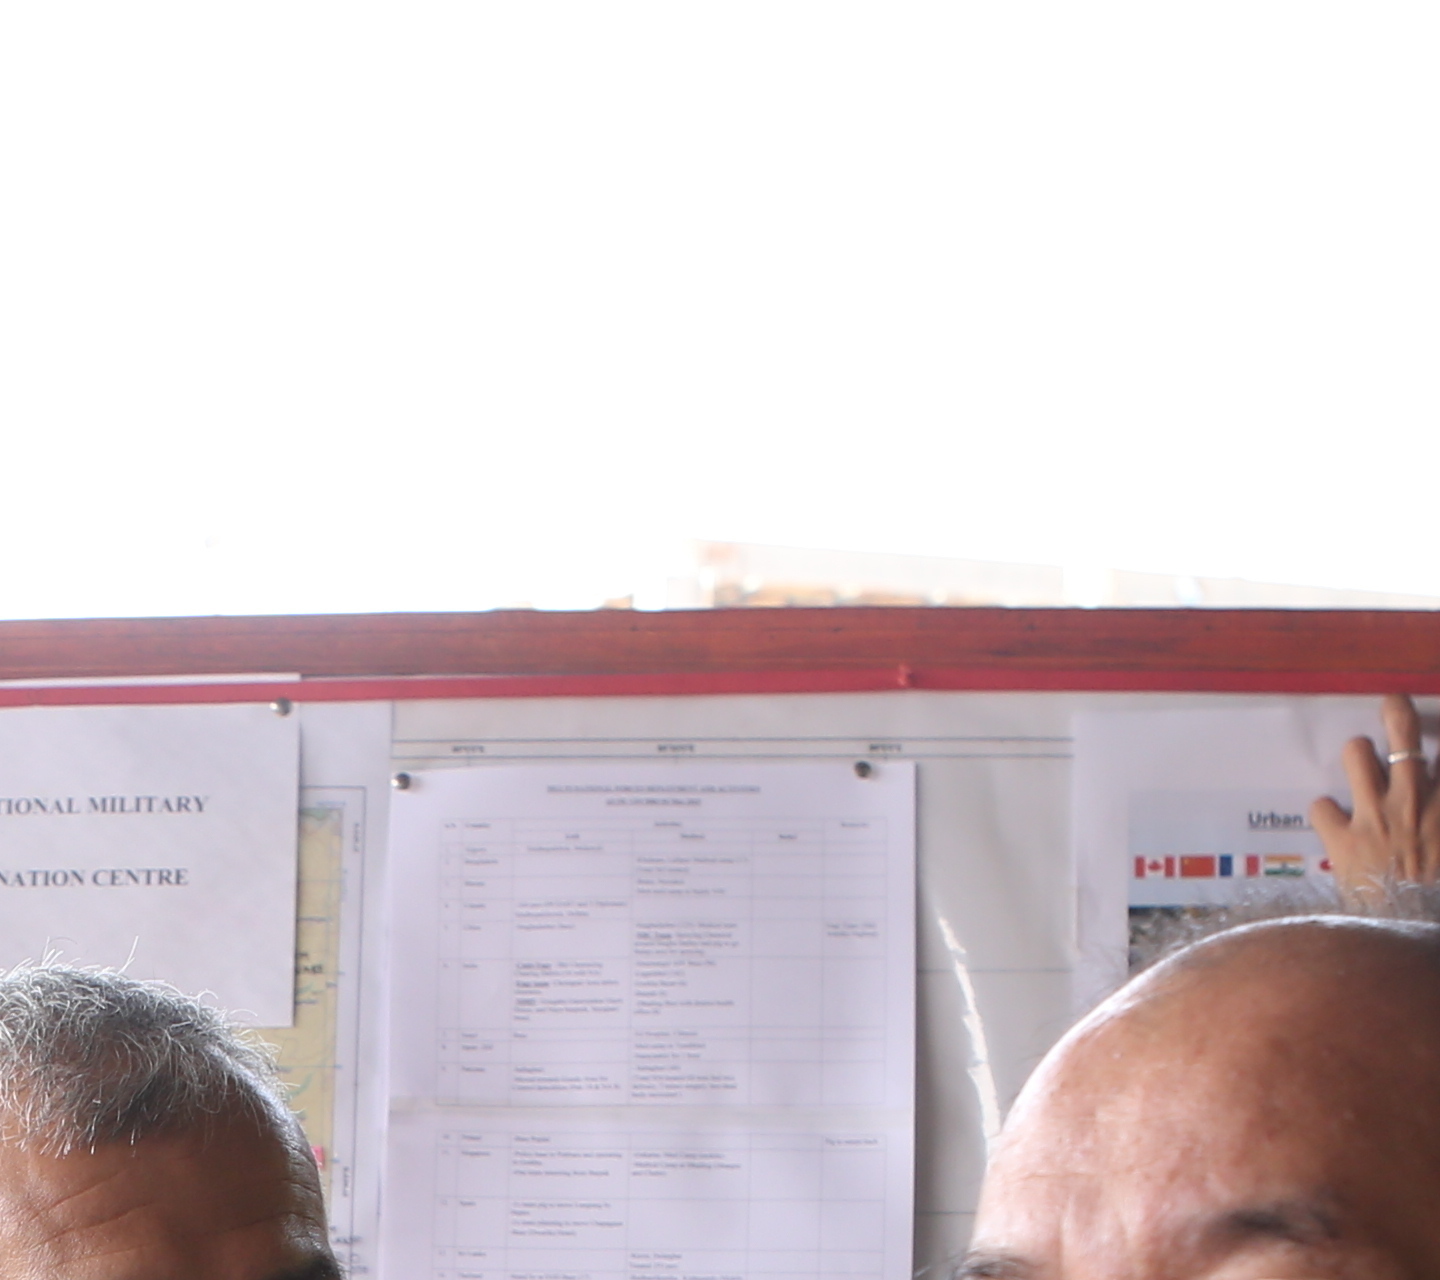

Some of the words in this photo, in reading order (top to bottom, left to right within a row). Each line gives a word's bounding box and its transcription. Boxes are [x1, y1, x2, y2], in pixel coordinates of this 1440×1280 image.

[87, 795, 209, 814] MILITARY
[1248, 811, 1304, 829] Urban
[92, 868, 189, 886] CENTRE
